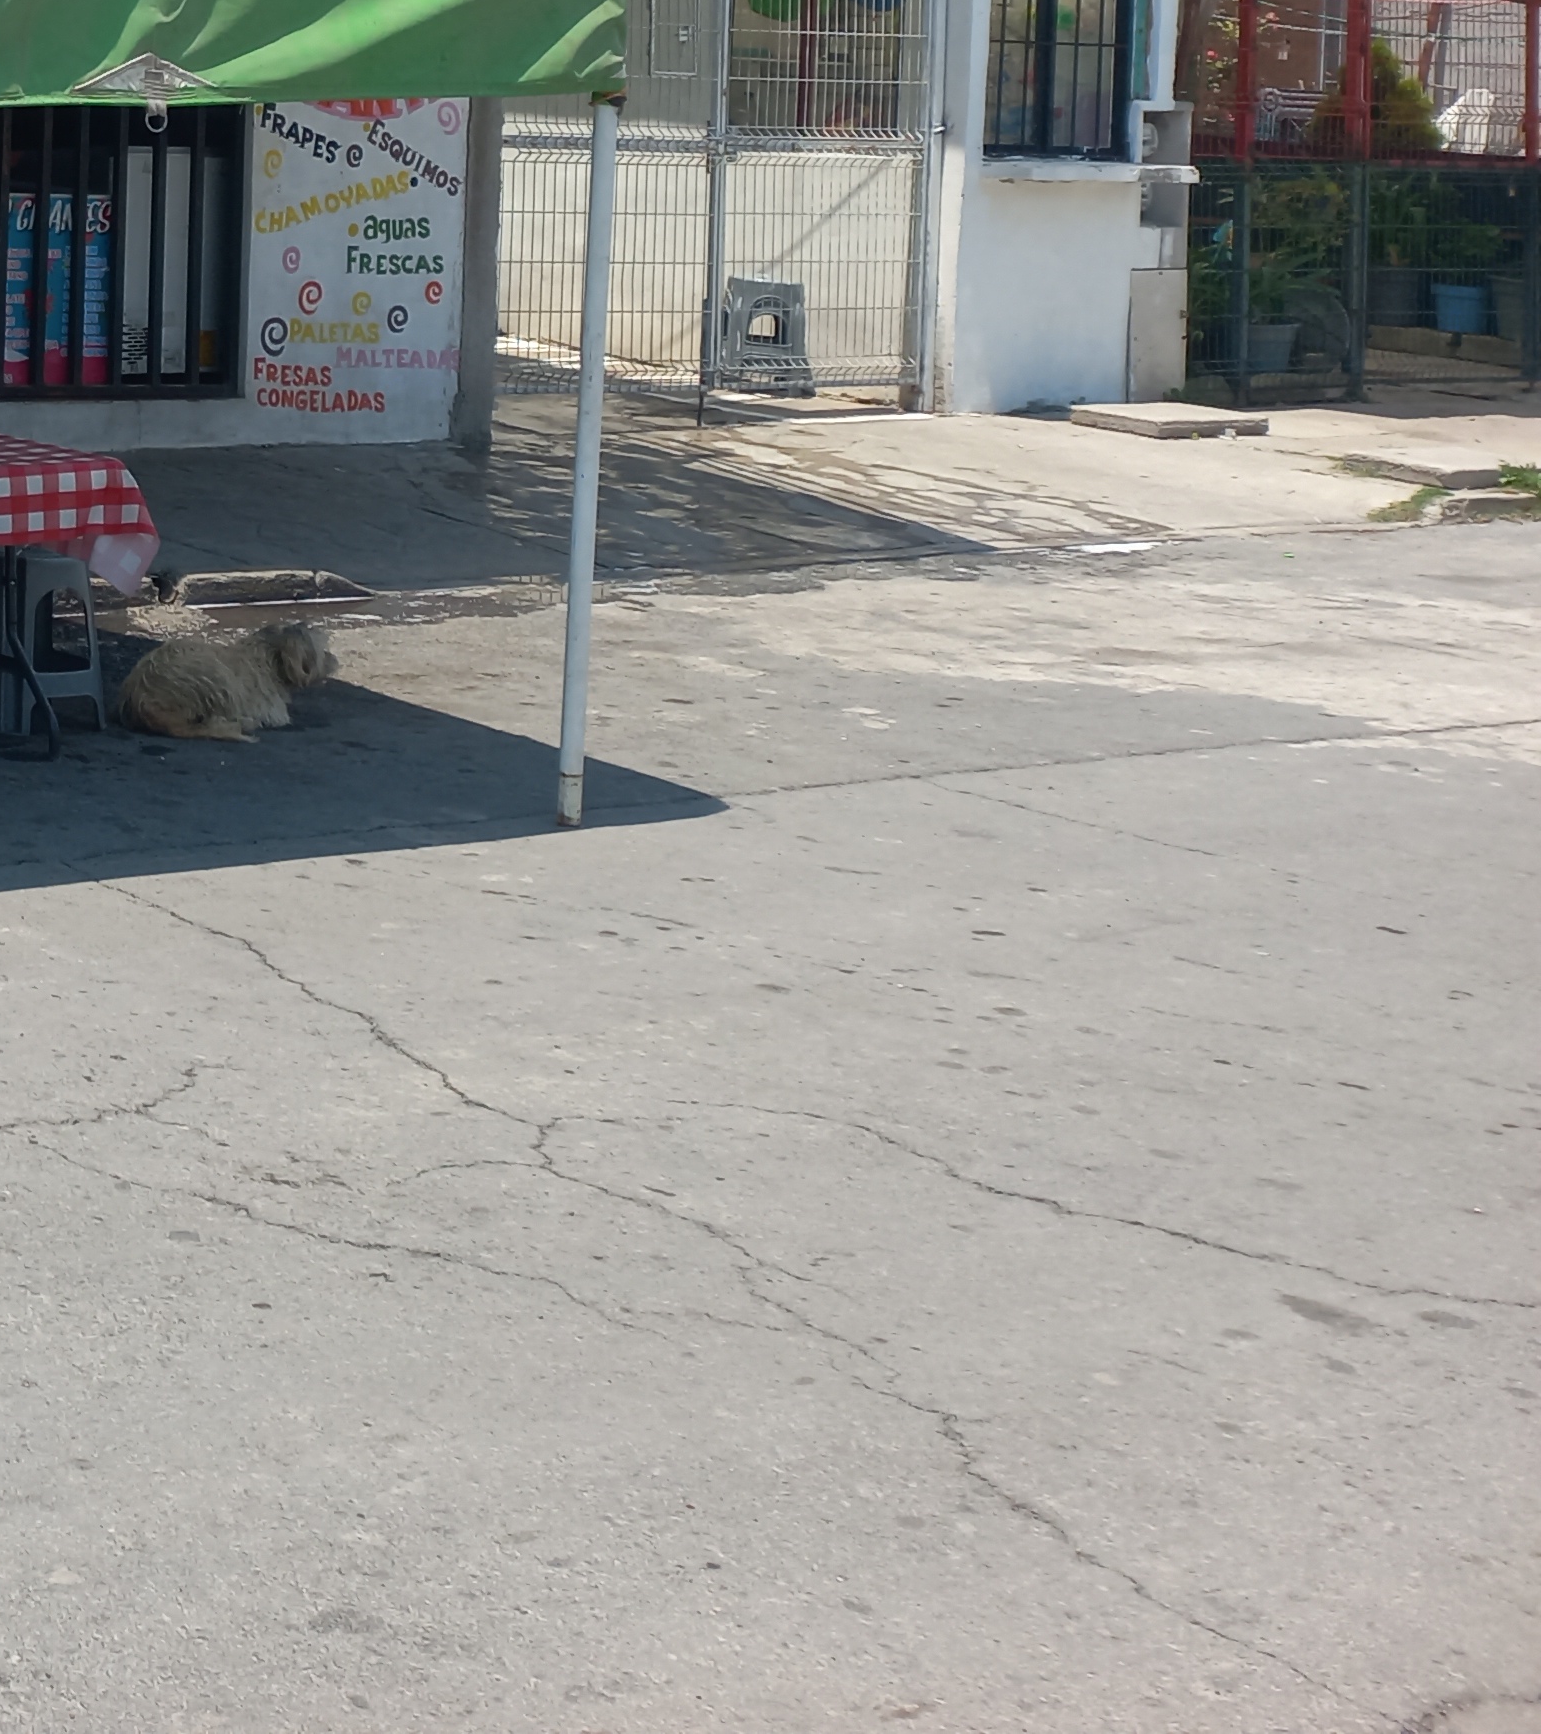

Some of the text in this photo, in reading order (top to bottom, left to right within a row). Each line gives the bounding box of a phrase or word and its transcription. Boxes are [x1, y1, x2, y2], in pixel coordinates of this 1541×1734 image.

[260, 103, 340, 163] FRAPES
[367, 118, 462, 196] ESQUIMOS
[254, 170, 409, 234] CHAMOYADAS
[346, 246, 445, 275] FRESCAS
[288, 318, 380, 344] PALETAS
[253, 357, 332, 387] FRESAS
[336, 346, 460, 370] MALTEADAS
[257, 388, 385, 413] CONGELADAS
